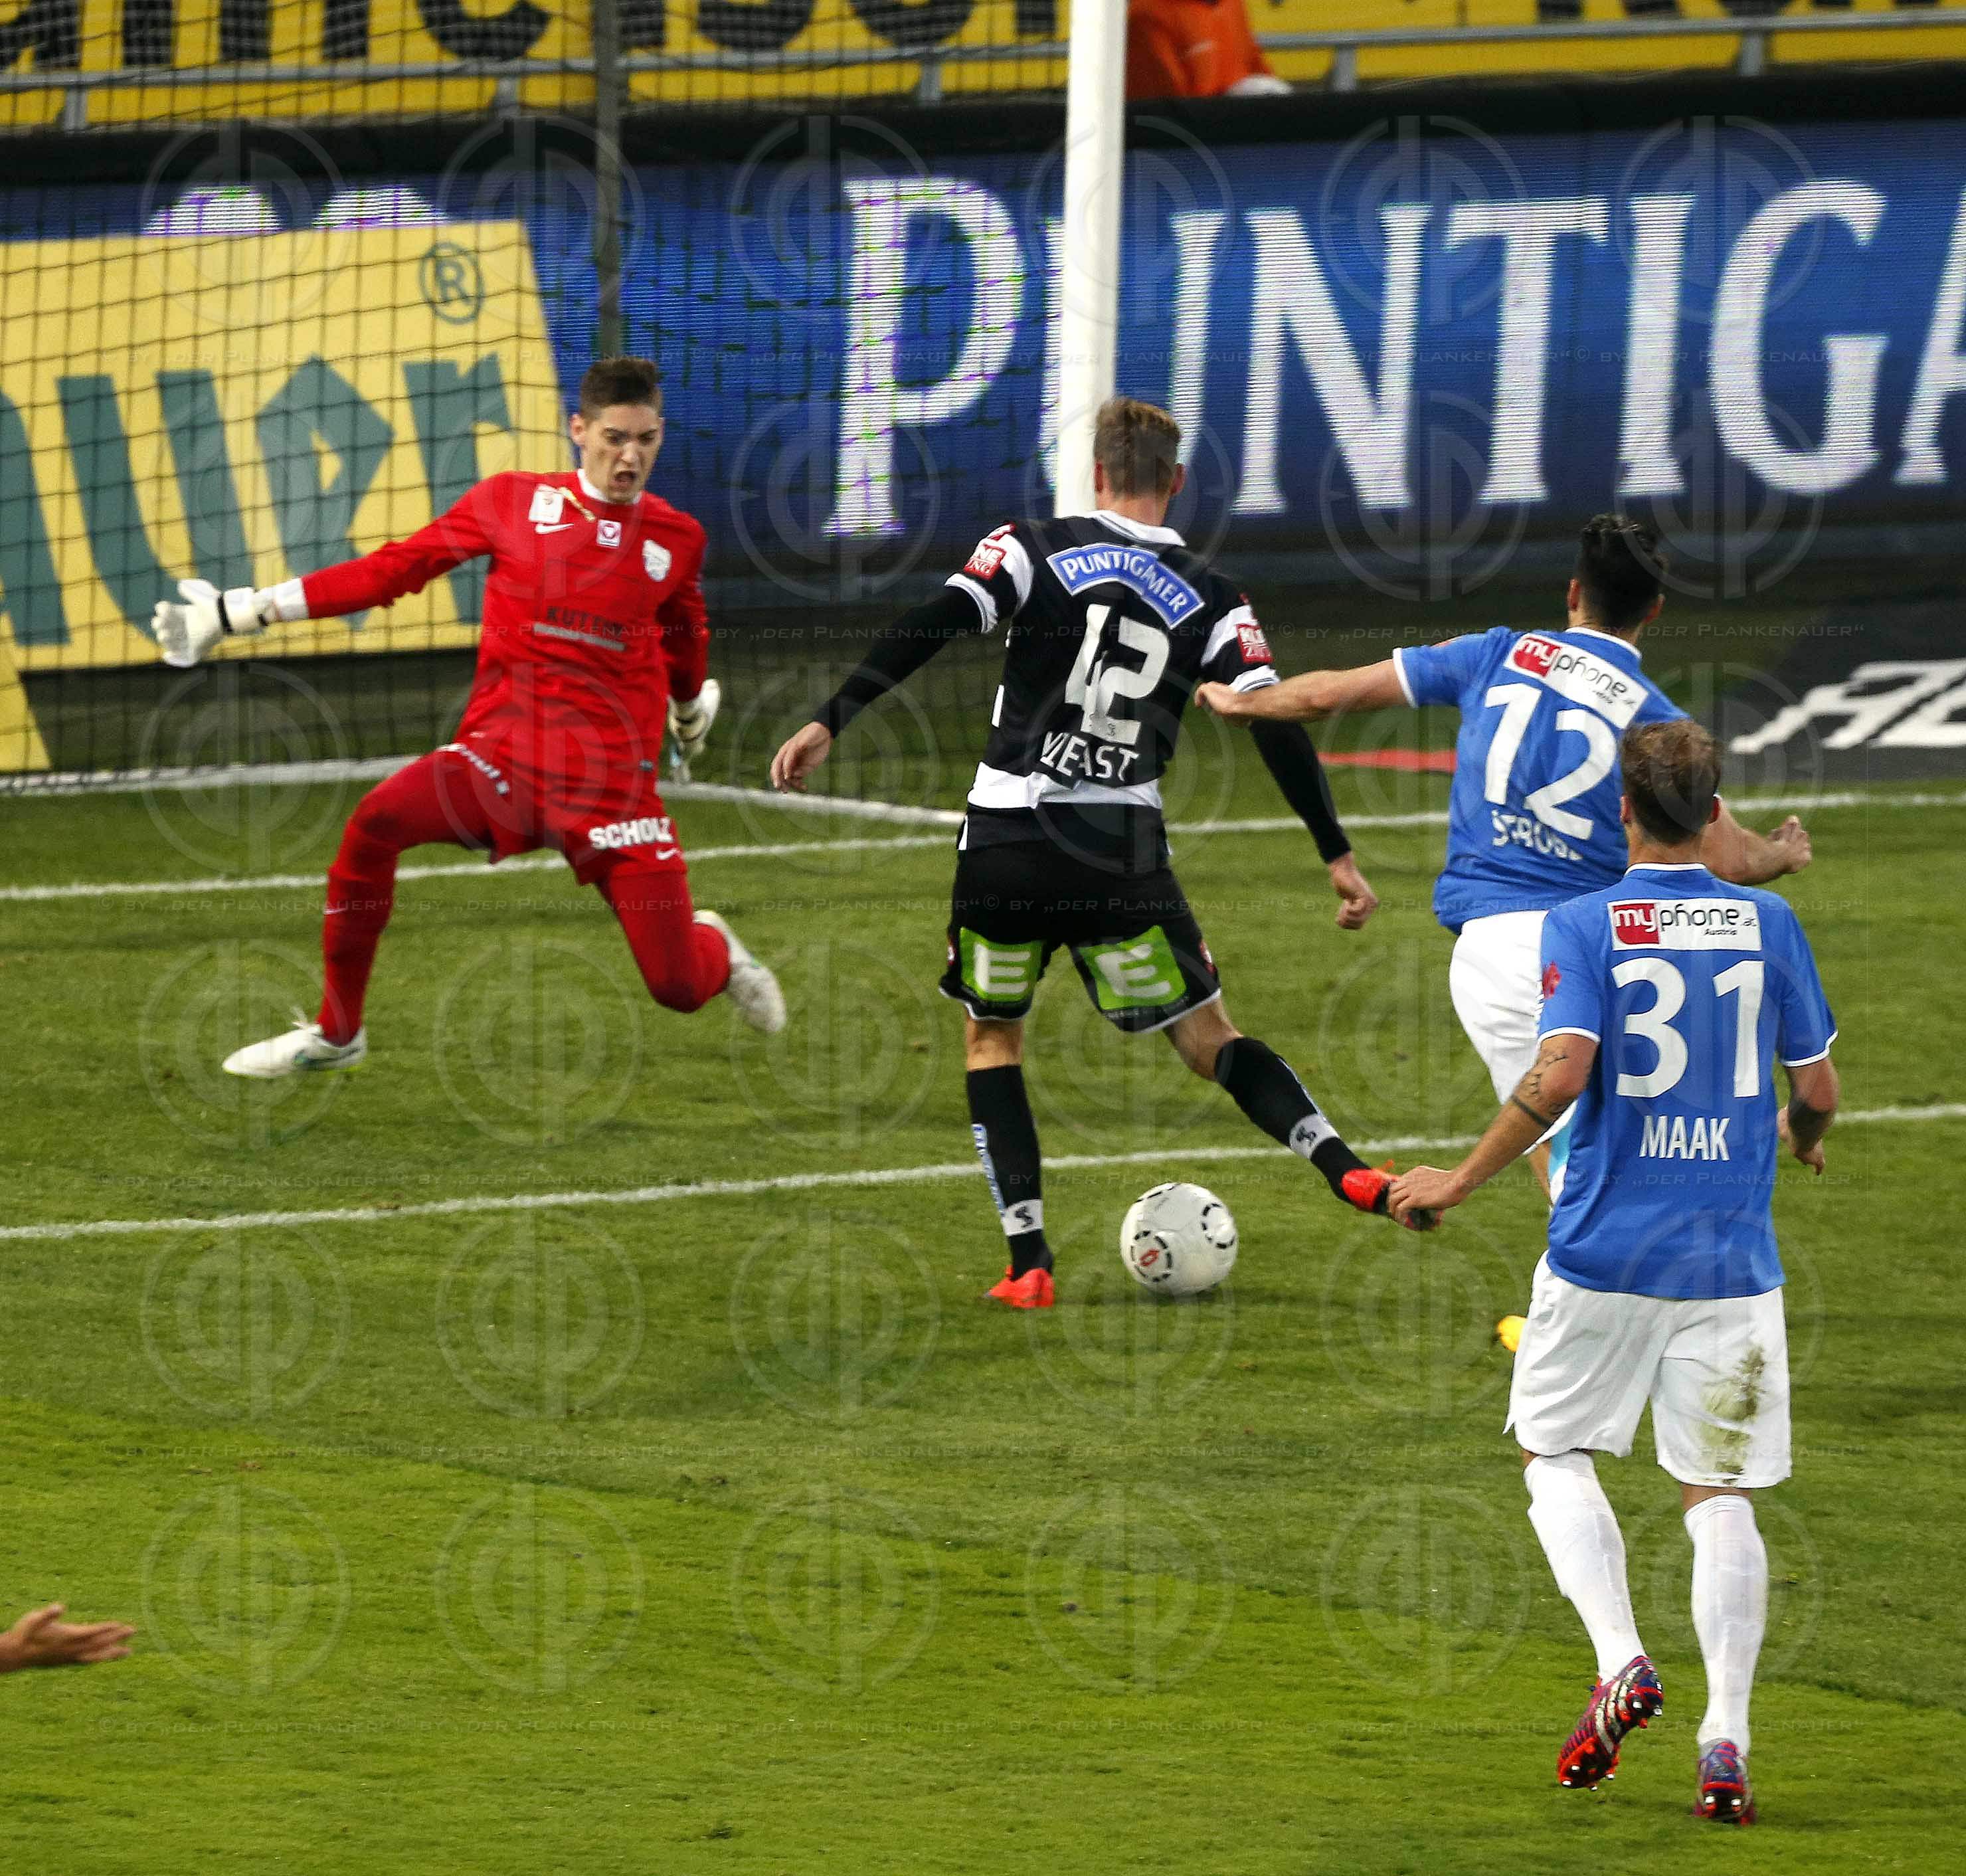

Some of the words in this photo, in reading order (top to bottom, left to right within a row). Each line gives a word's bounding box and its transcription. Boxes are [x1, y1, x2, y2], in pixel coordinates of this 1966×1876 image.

[1484, 682, 1617, 840] 12
[1611, 956, 1766, 1098] 31
[1639, 1115, 1730, 1161] MAAK
